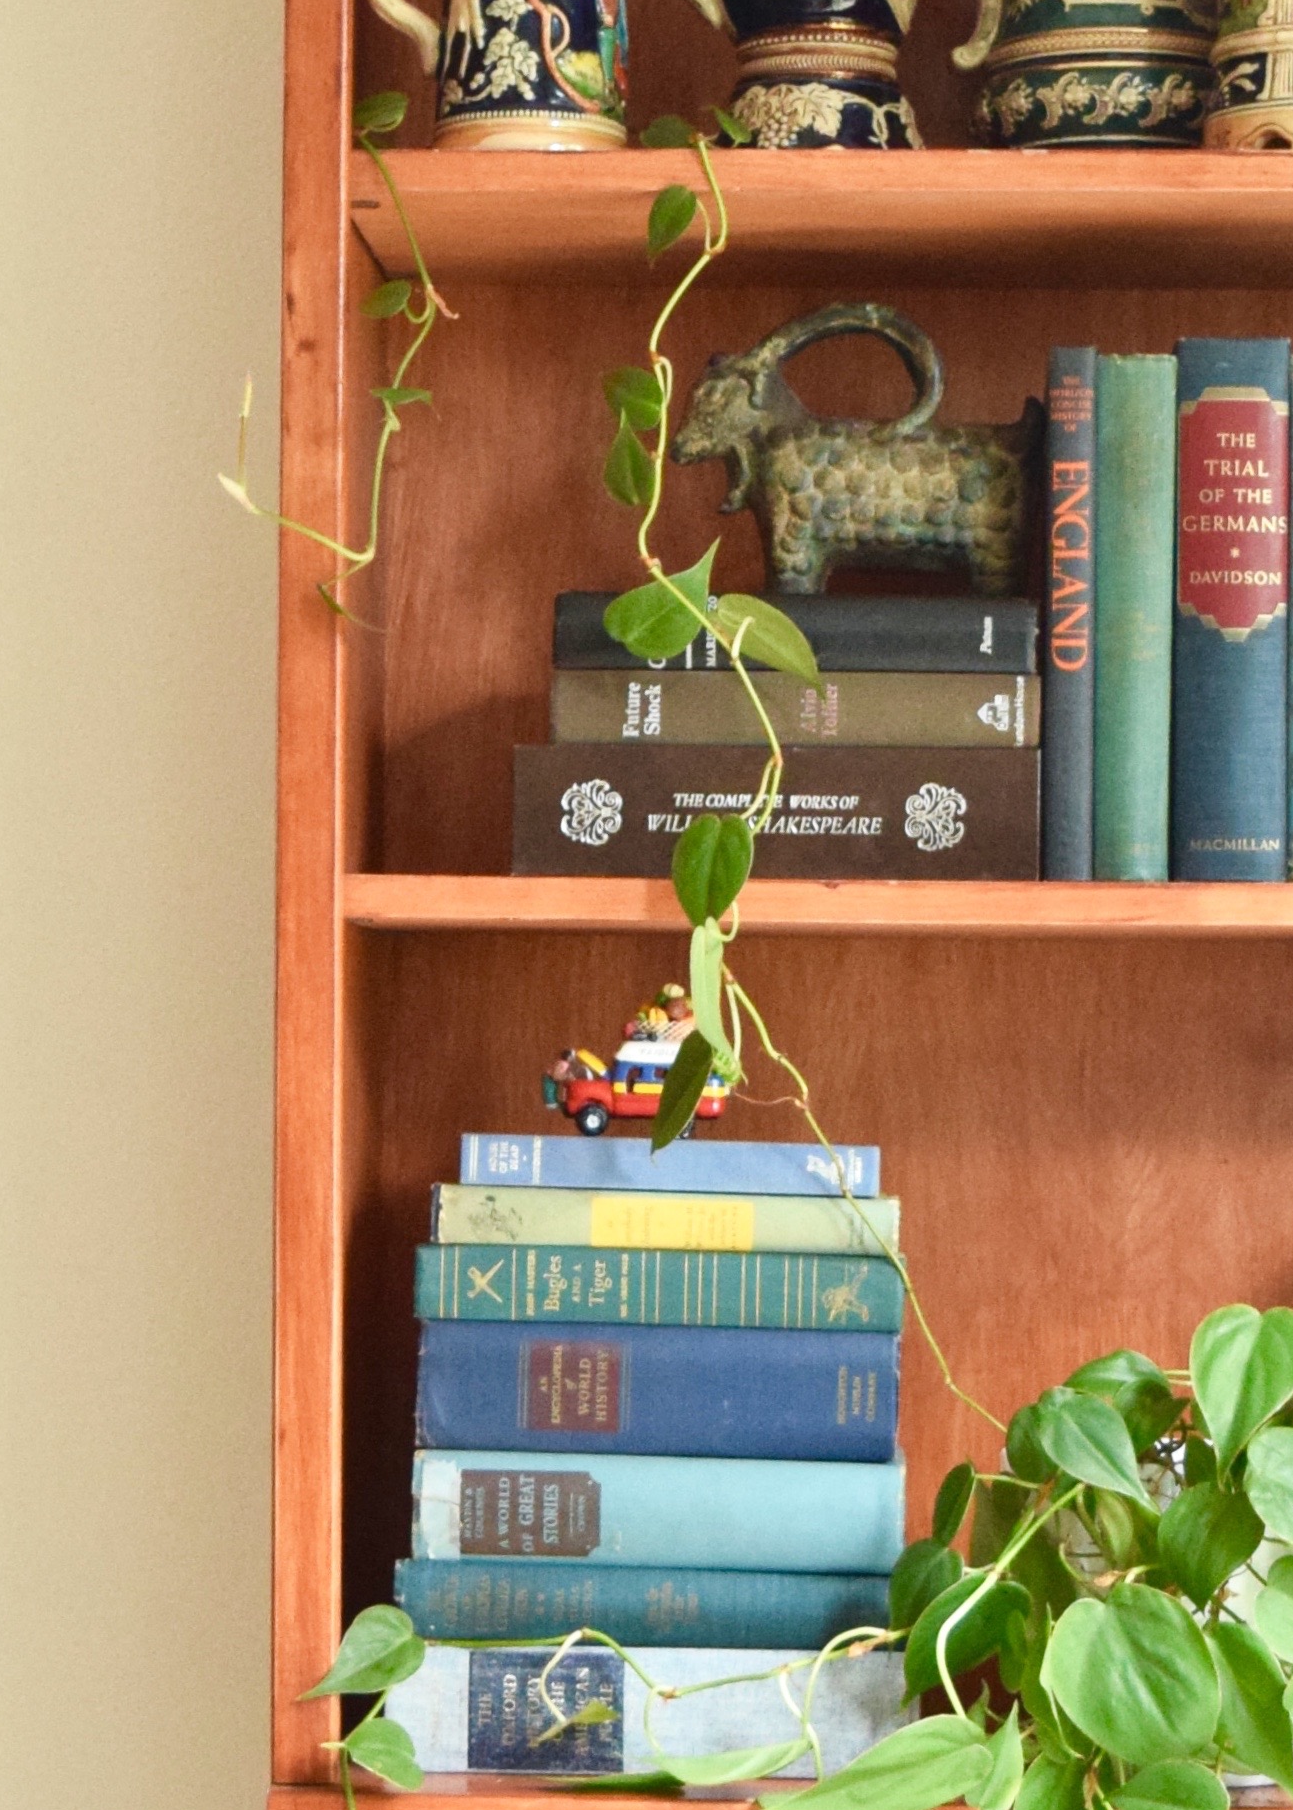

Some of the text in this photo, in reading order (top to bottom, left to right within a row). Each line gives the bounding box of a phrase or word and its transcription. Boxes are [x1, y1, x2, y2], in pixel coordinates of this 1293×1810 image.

[1216, 433, 1257, 449] THE
[1203, 460, 1269, 478] TRIAL
[1198, 488, 1274, 506] OF THE
[1182, 516, 1288, 534] GERMANS
[1052, 460, 1091, 672] ENGLAND
[1189, 570, 1283, 587] DAVIDSON
[623, 682, 642, 738] Future
[643, 684, 662, 735] Shock
[673, 793, 860, 810] THE WORKS OF
[1189, 838, 1281, 852] MACMILLAN
[543, 1255, 567, 1312] Bugles
[571, 1263, 582, 1303] AND A
[588, 1259, 613, 1307] Tiger
[577, 1357, 592, 1416] WORLD
[595, 1350, 609, 1422] HISTORY
[497, 1476, 511, 1549] A WORLD
[517, 1472, 535, 1552] OF GREAT
[542, 1483, 559, 1545] STORIES
